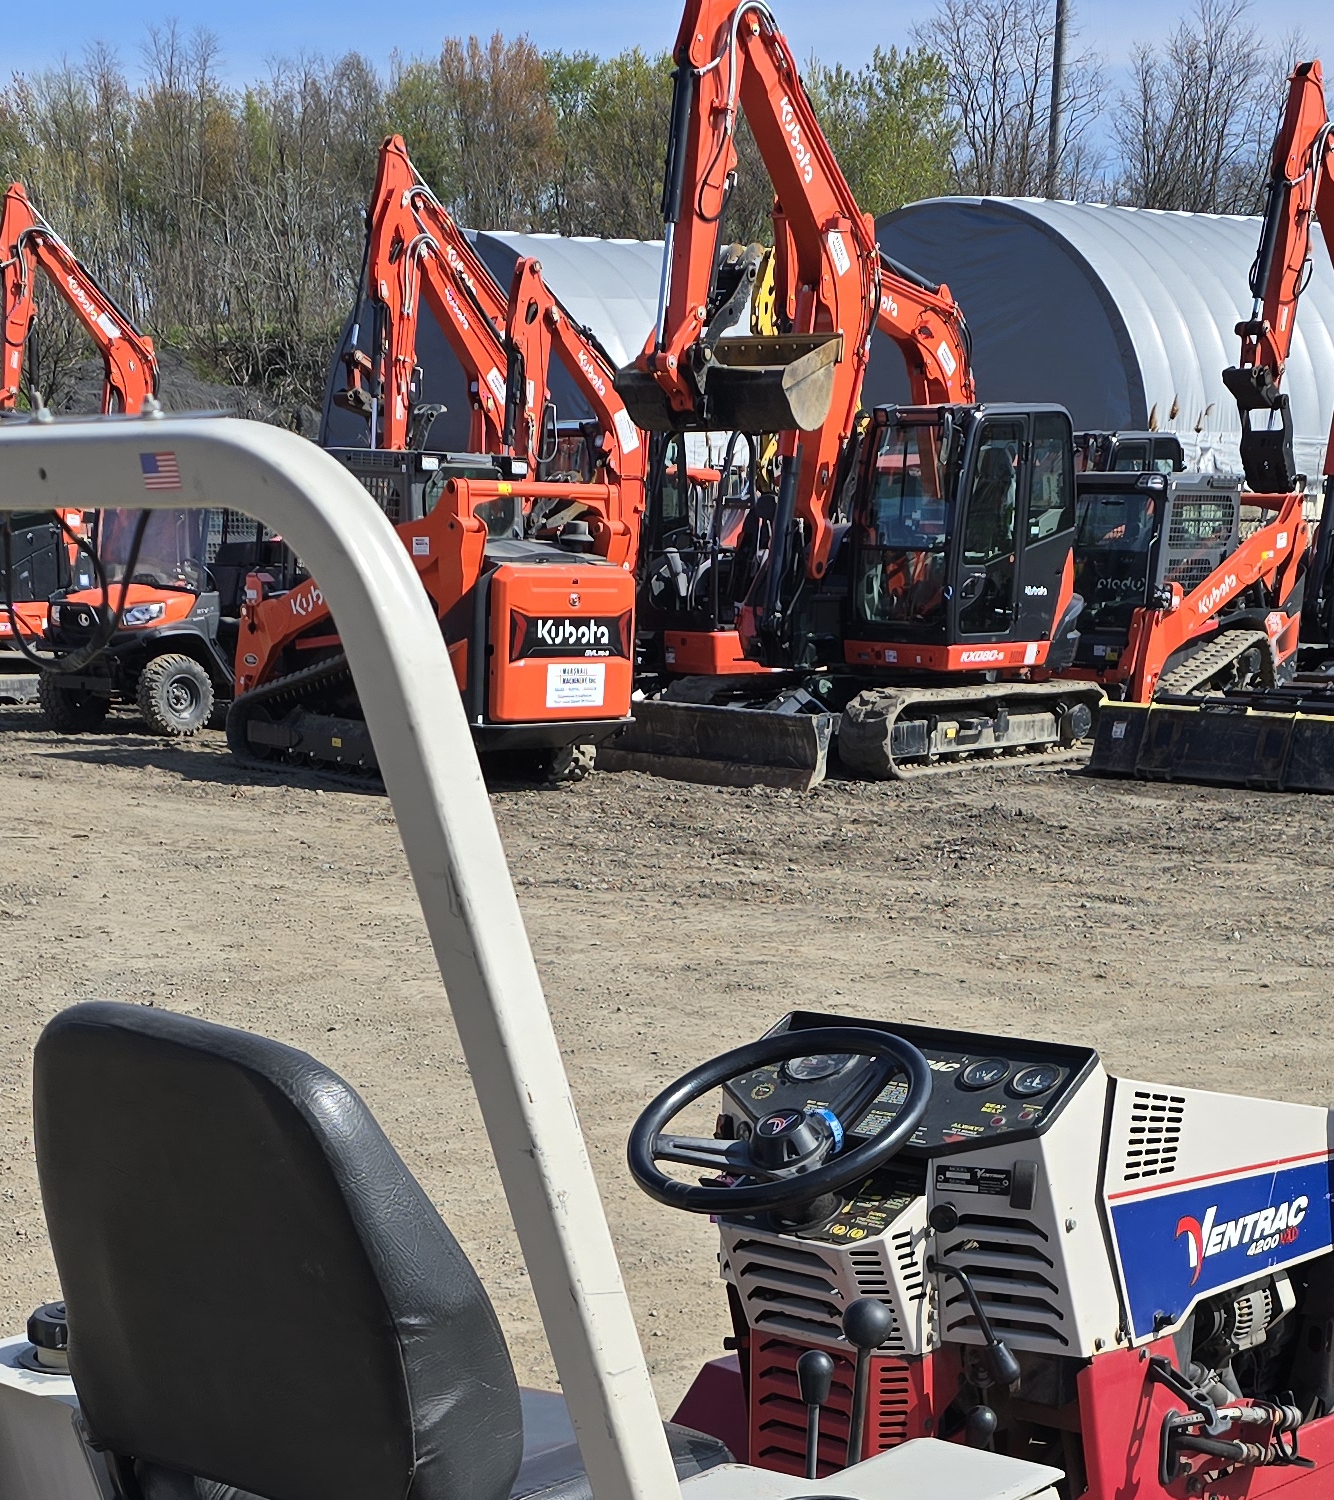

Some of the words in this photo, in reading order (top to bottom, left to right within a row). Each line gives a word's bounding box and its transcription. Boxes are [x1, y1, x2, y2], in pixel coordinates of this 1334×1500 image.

[780, 96, 814, 184] Kubota
[66, 275, 98, 322] Kubota
[880, 295, 898, 318] ota
[577, 349, 606, 397] Kubota
[290, 585, 324, 616] Kub
[1197, 573, 1237, 614] Kubota
[537, 619, 609, 645] Kubota
[1174, 1195, 1309, 1287] VENTRAC
